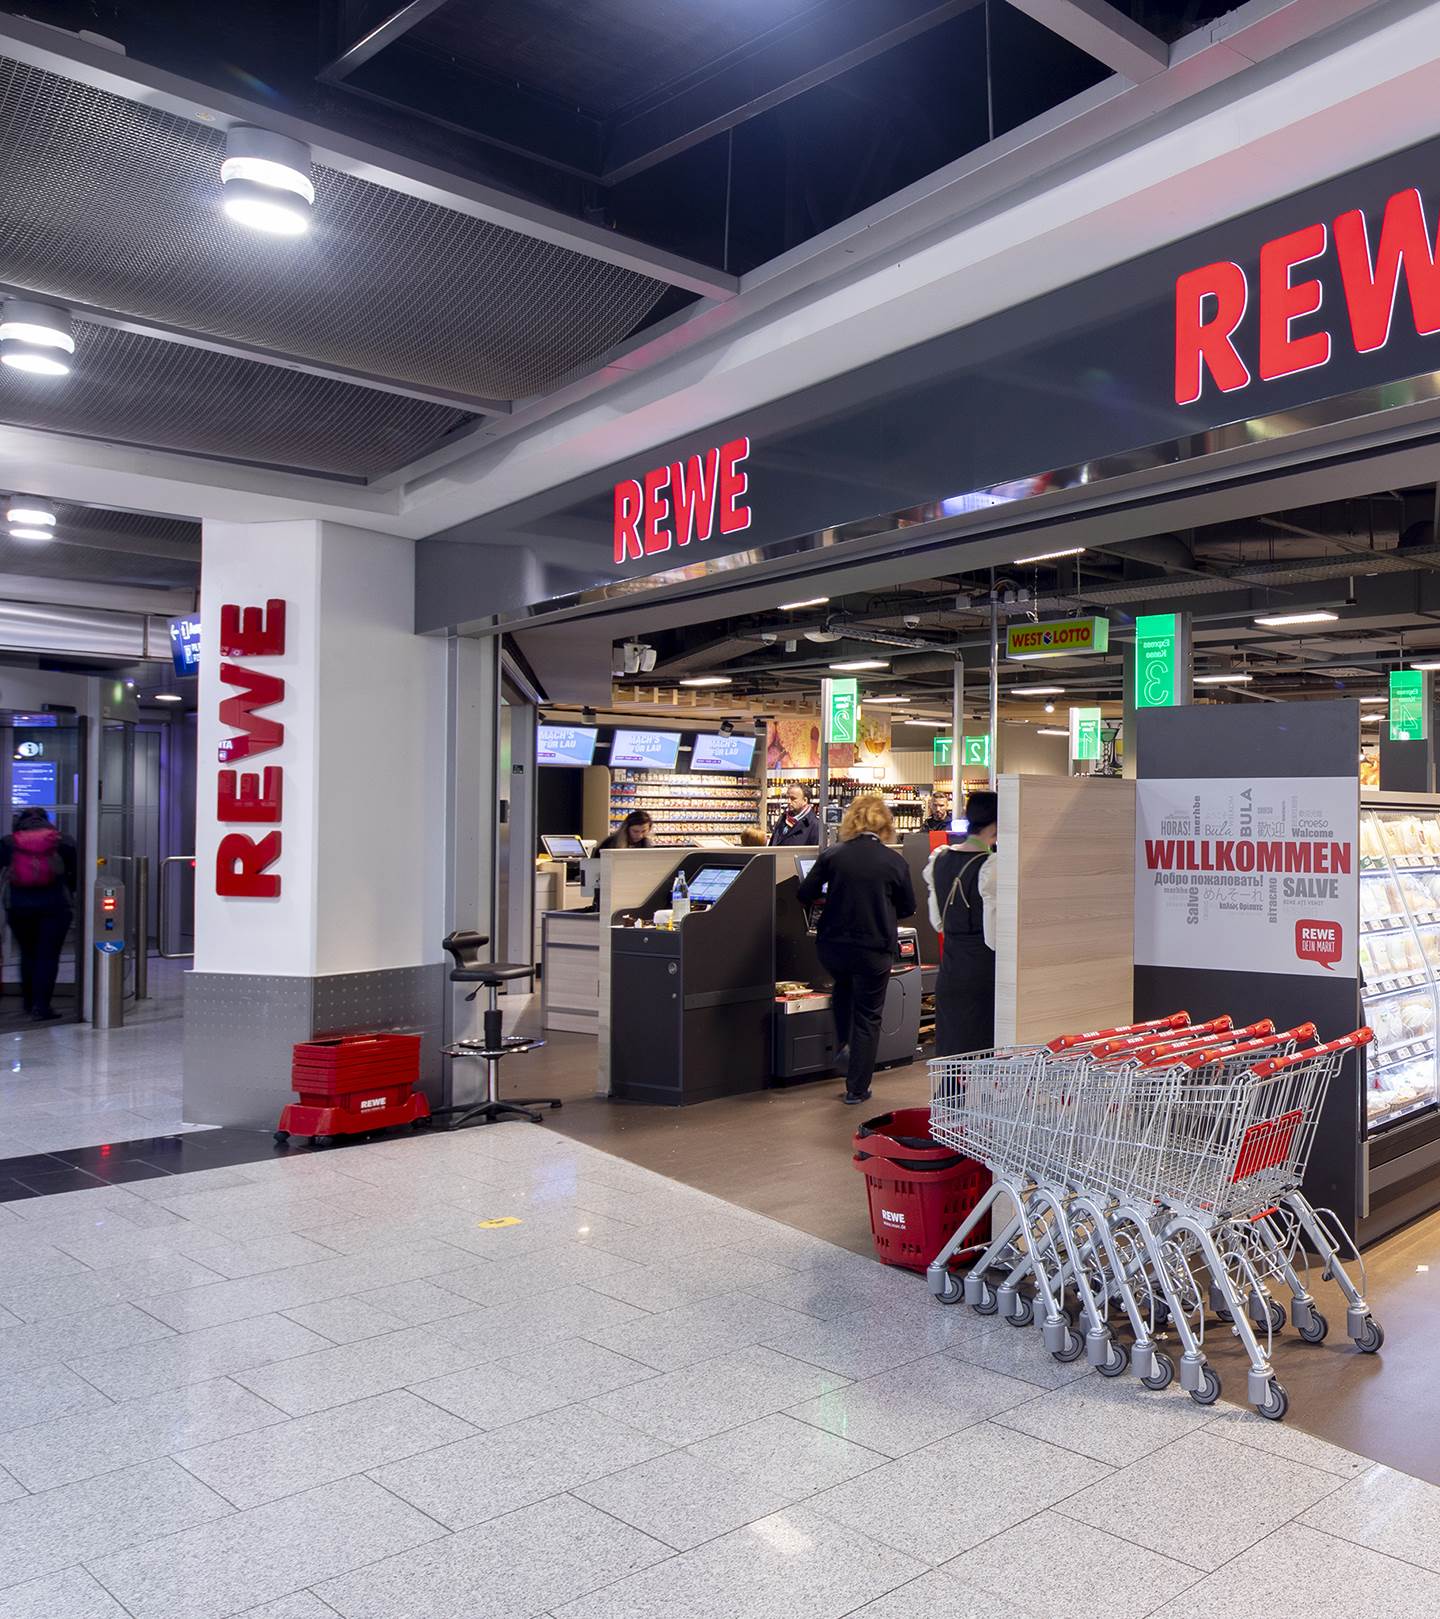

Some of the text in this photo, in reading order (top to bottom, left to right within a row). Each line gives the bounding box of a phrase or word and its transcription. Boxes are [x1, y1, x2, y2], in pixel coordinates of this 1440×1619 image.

[612, 434, 754, 565] REWE
[1012, 626, 1091, 647] WEST LOTTO
[216, 599, 286, 897] REWE
[1240, 787, 1253, 837] BULA
[1161, 820, 1191, 836] HORAS!
[1145, 840, 1352, 875] WILLKOMMEN
[1154, 871, 1264, 888] Добро пожаловать!
[1283, 876, 1340, 899] SALVE
[1186, 886, 1200, 925] Salve
[1302, 927, 1335, 941] REWE
[1302, 940, 1335, 953] DEIN MARKT
[360, 1097, 387, 1109] REWE
[881, 1209, 906, 1223] REWE
